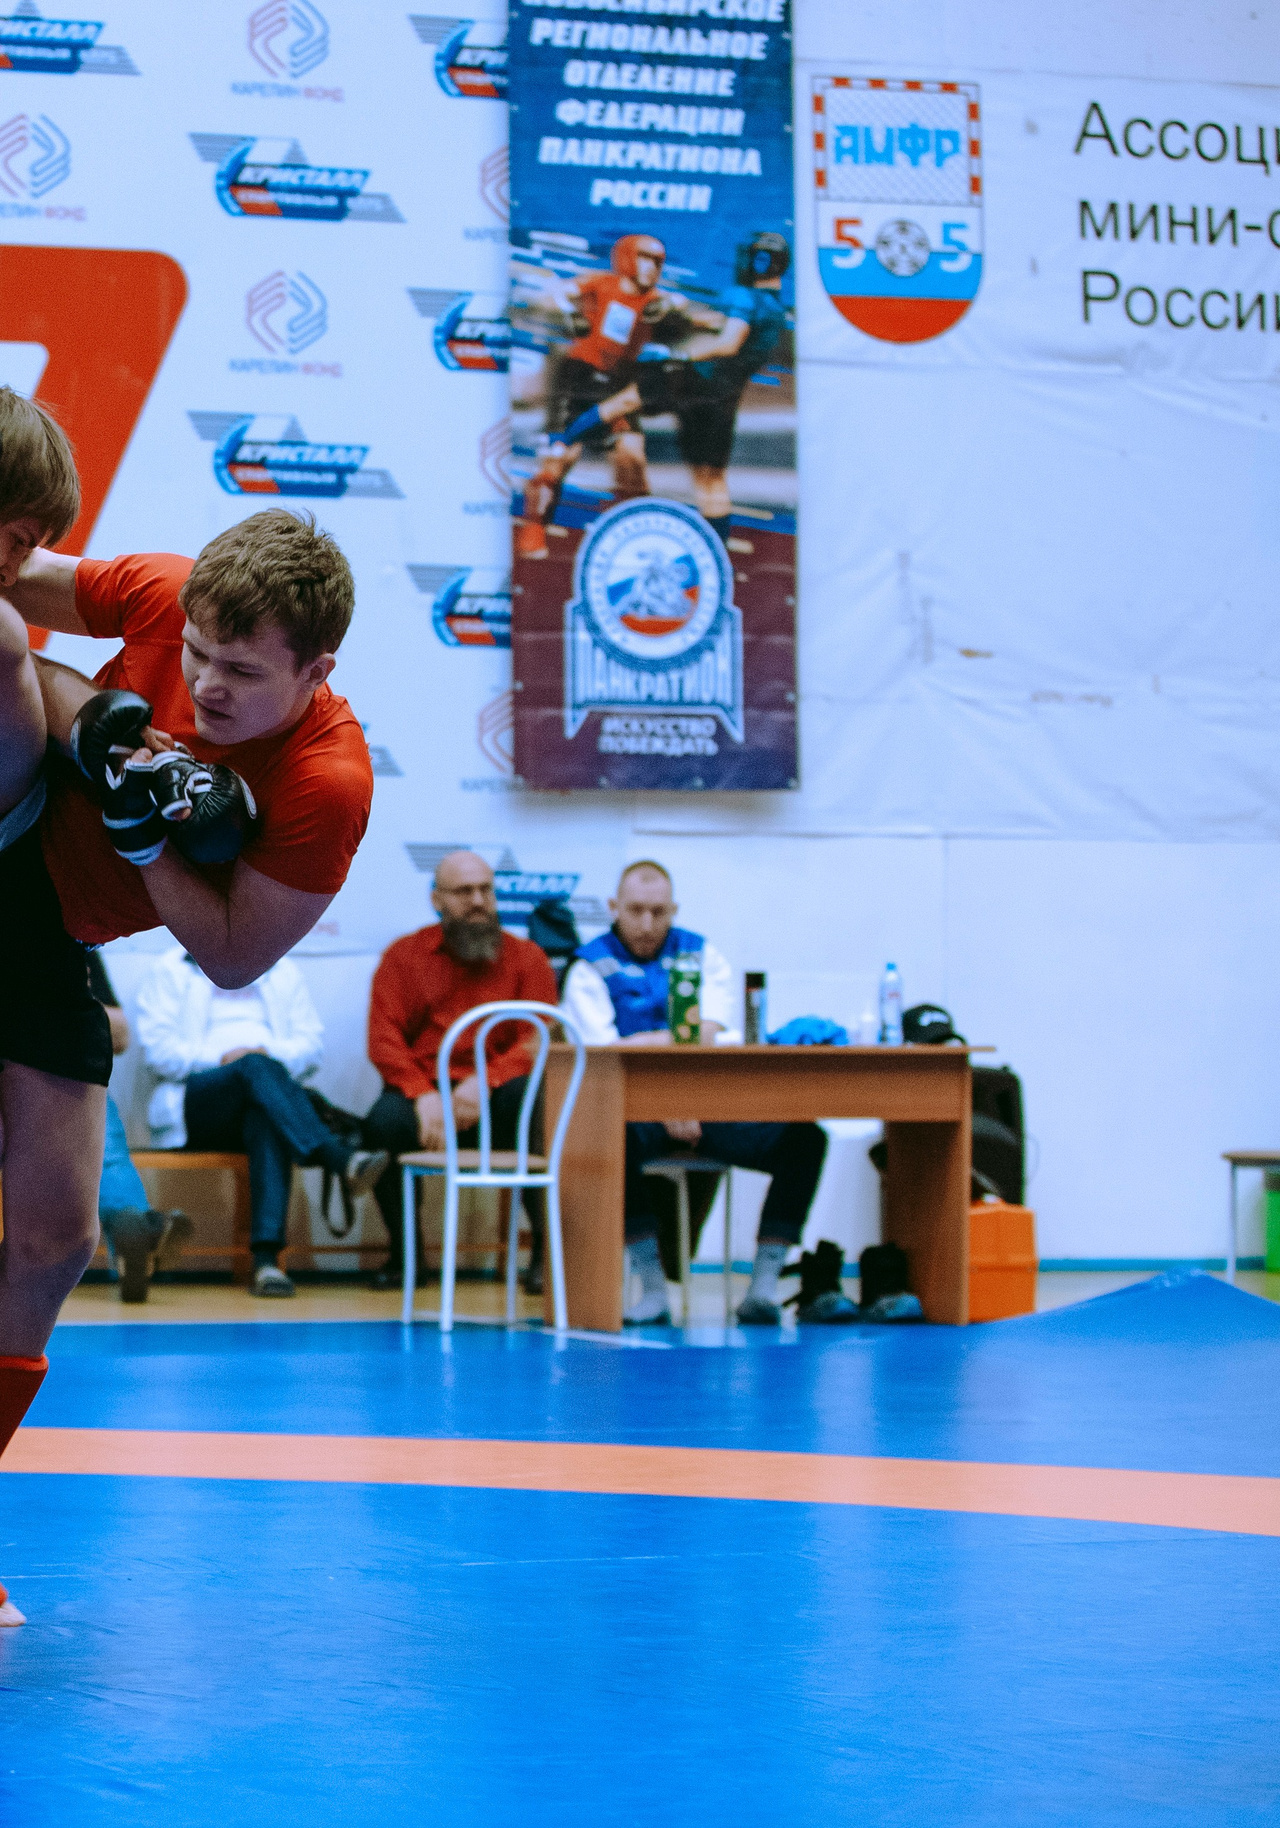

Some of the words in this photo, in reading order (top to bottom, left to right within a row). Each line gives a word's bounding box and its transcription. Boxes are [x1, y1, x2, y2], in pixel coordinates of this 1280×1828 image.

[529, 17, 769, 60] РЕГИОНАЛЬНОЕ
[563, 59, 736, 97] ОТДЕЛЕНИЕ
[554, 98, 745, 137] ФЕДЕРАЦИИ
[1074, 101, 1280, 176] Ассоц
[538, 136, 762, 176] ПАНКРАТИОНА
[590, 178, 713, 213] РОССИИ
[832, 217, 867, 269] 5
[939, 221, 973, 273] 5
[1081, 270, 1280, 331] Росси
[575, 615, 732, 706] ПАНКРАТИОН
